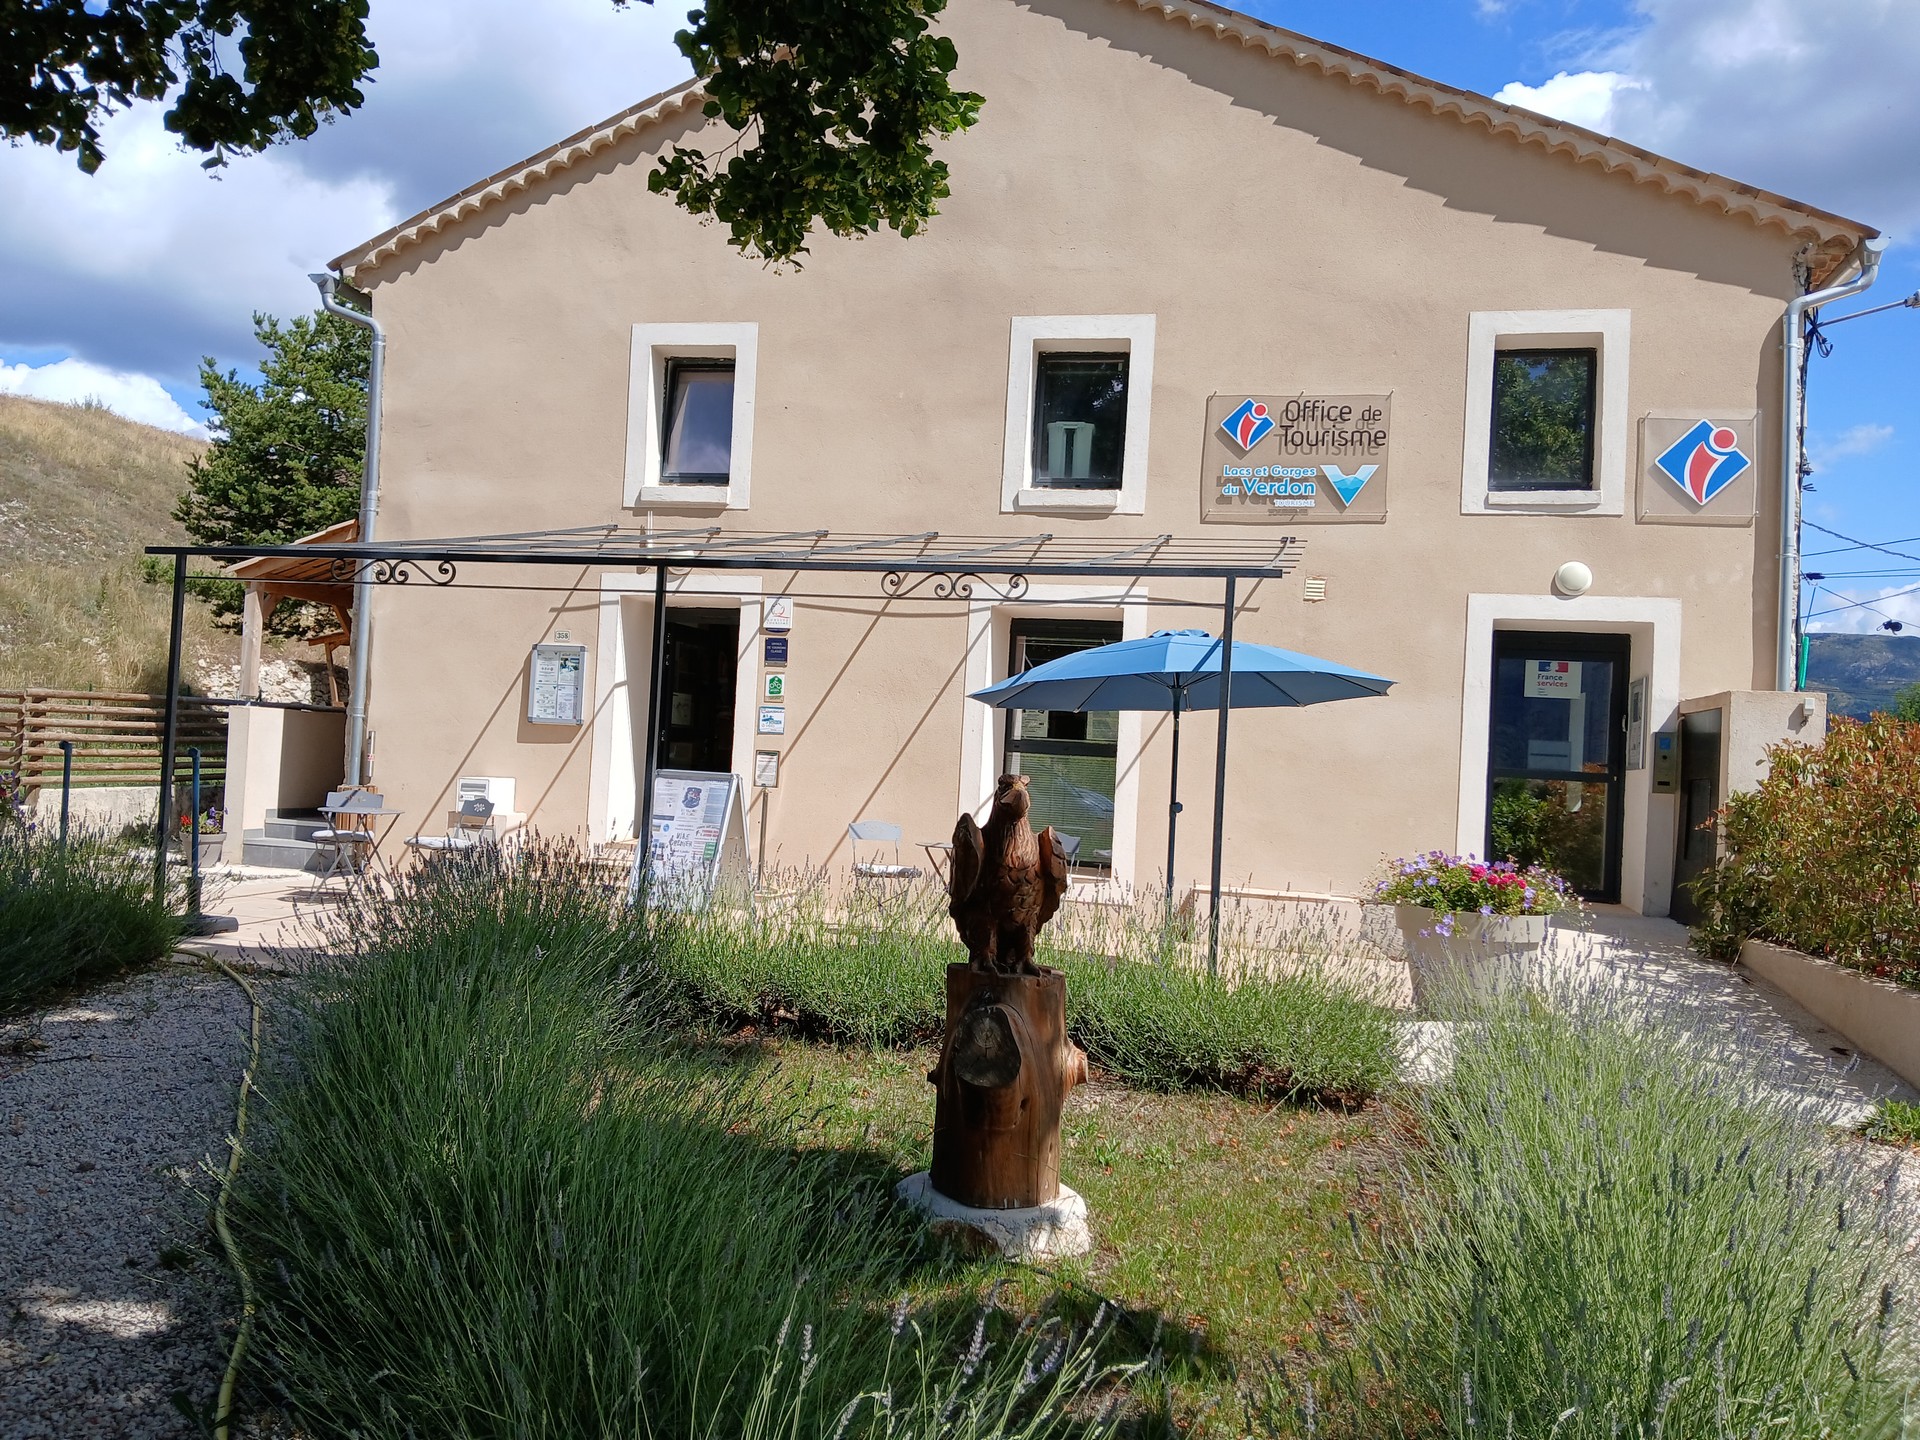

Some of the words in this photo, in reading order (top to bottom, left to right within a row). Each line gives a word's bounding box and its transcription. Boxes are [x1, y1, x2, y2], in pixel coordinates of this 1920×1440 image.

[1285, 400, 1352, 422] Office
[1362, 405, 1382, 421] de
[1280, 424, 1387, 447] Tourisme
[1224, 465, 1251, 476] Lacs
[1255, 466, 1269, 476] et
[1271, 465, 1316, 478] Gorges
[1223, 484, 1239, 495] du
[1242, 478, 1316, 494] Verdon
[1274, 499, 1315, 507] TOURISME
[557, 632, 569, 640] 358
